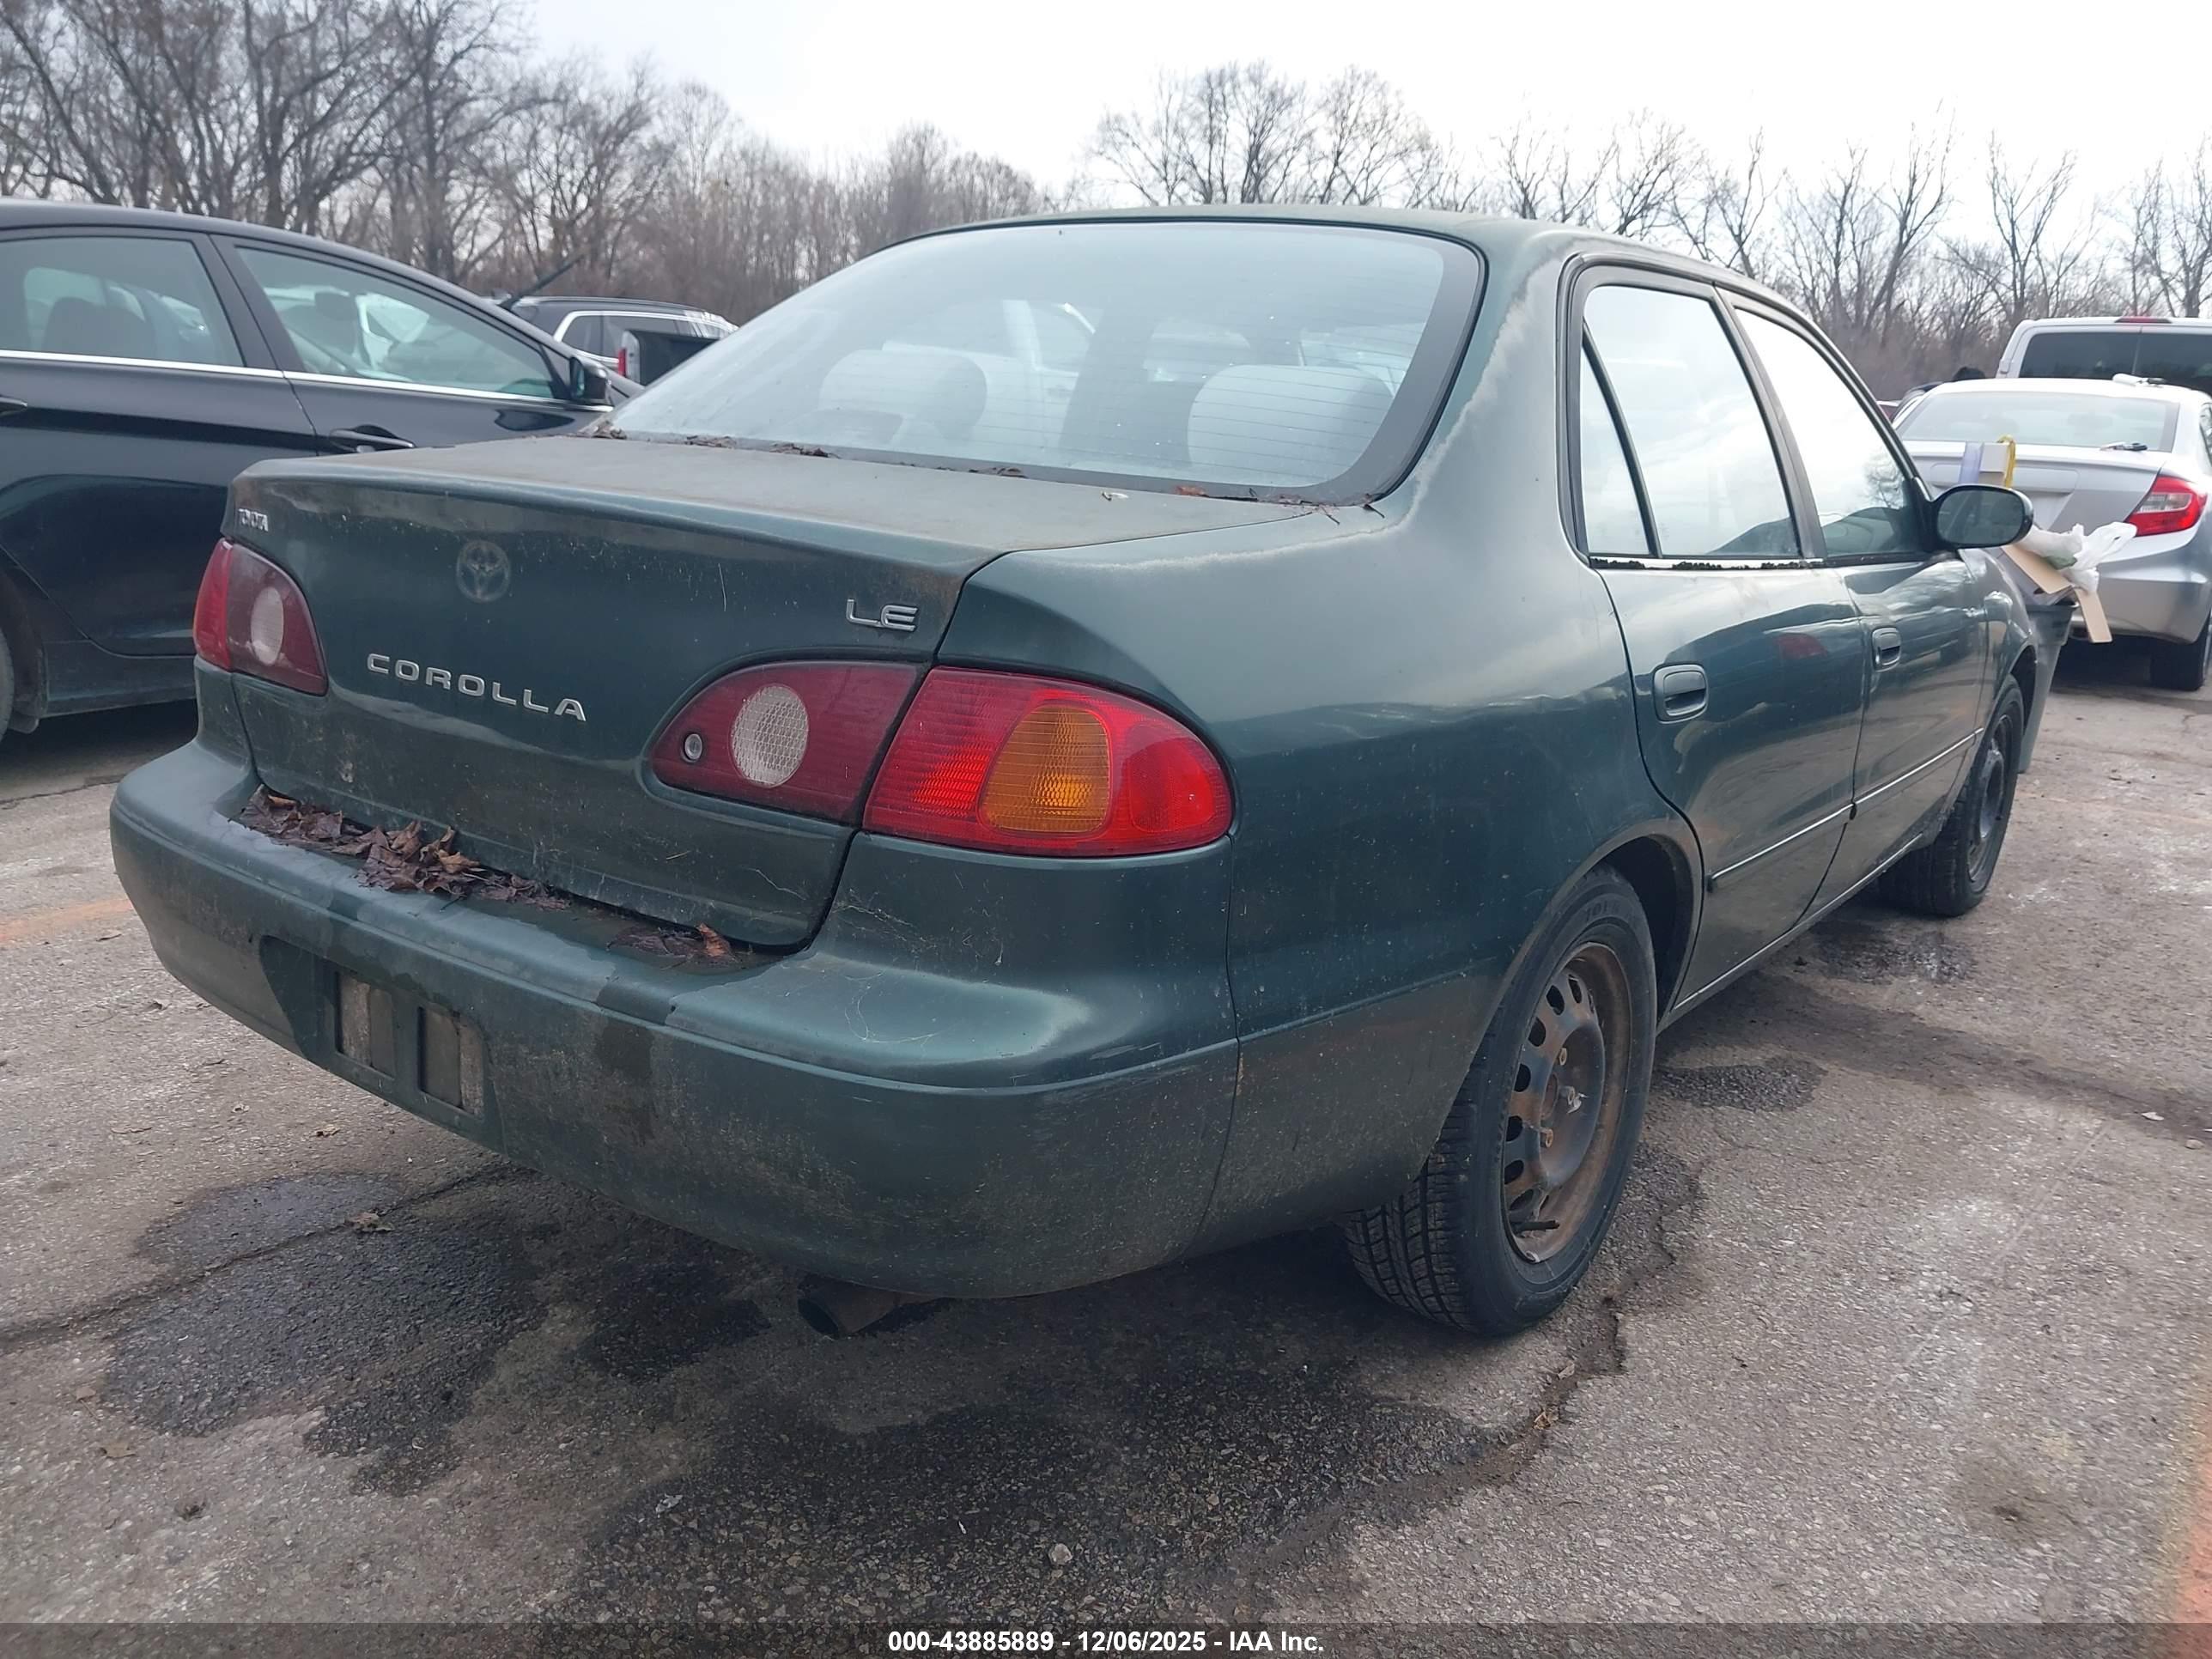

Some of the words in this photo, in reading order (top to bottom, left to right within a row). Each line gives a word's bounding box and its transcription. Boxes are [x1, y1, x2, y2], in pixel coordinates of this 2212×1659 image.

[239, 507, 269, 532] TOOTA
[845, 599, 918, 631] LE
[367, 653, 587, 722] COROLLA
